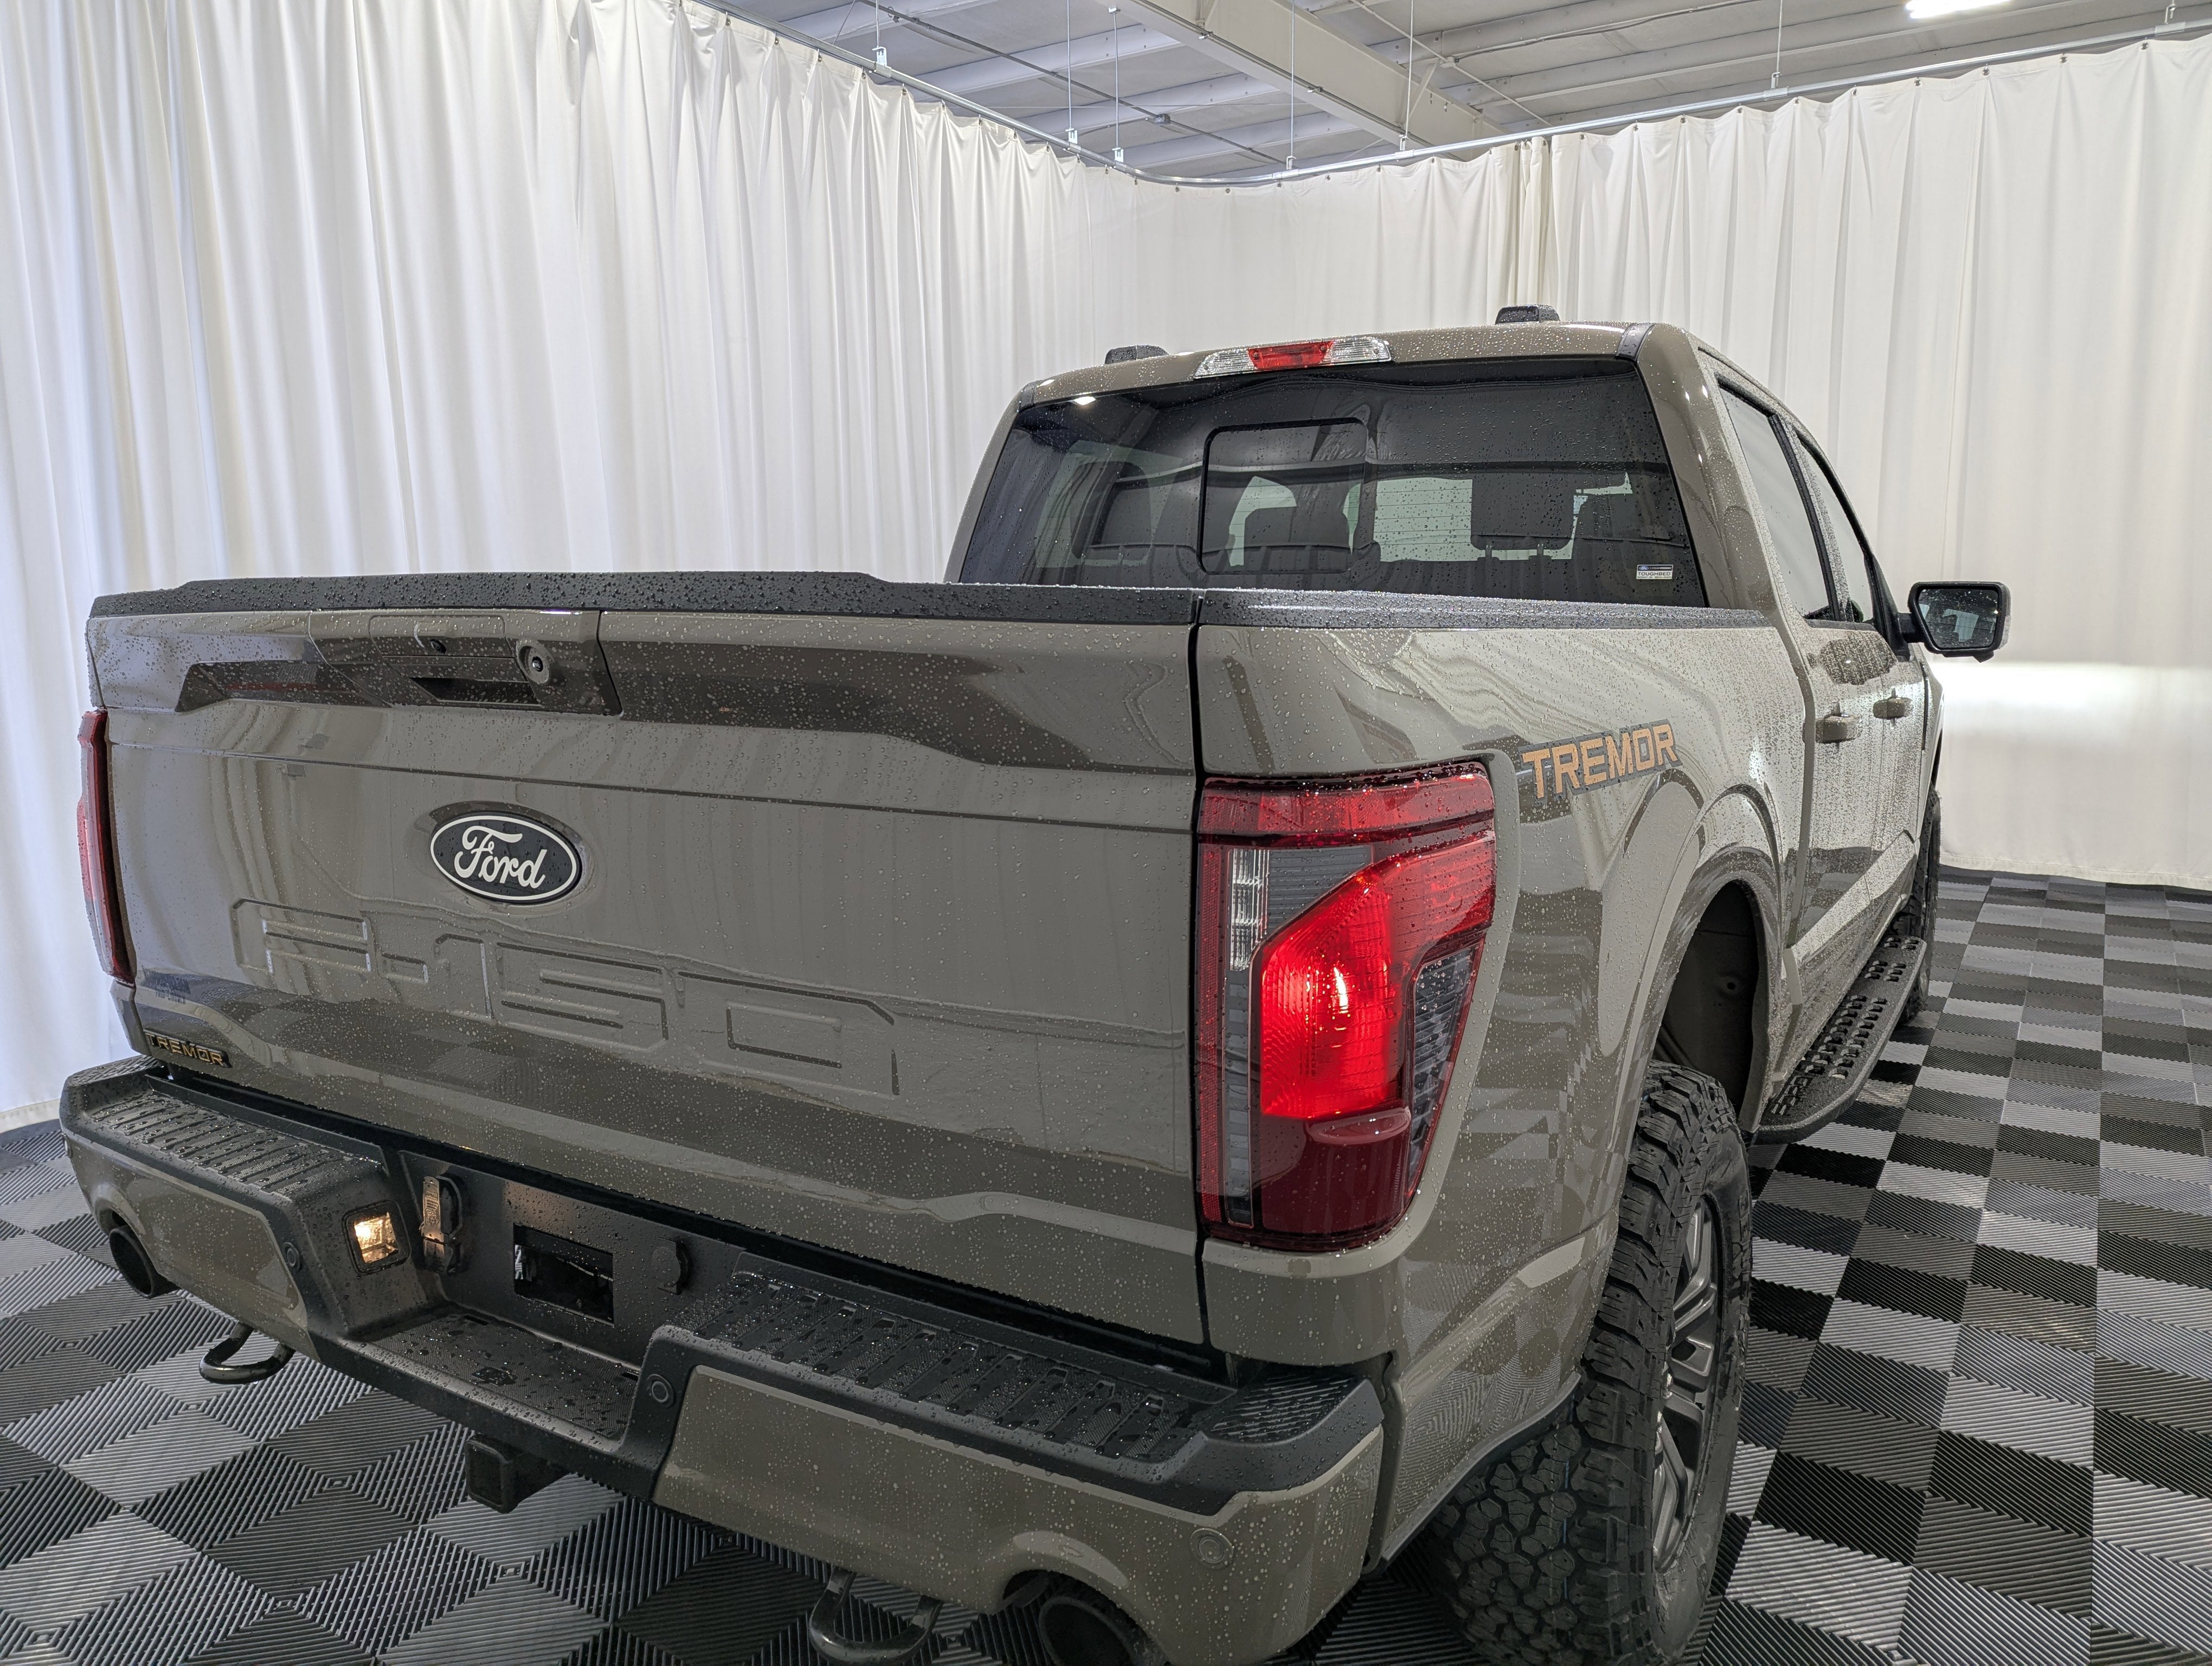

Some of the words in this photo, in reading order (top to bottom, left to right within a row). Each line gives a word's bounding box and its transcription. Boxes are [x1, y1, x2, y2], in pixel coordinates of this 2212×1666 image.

[1522, 724, 1679, 799] TREMOR
[454, 825, 545, 889] Ford
[145, 1032, 224, 1066] TREMOR
